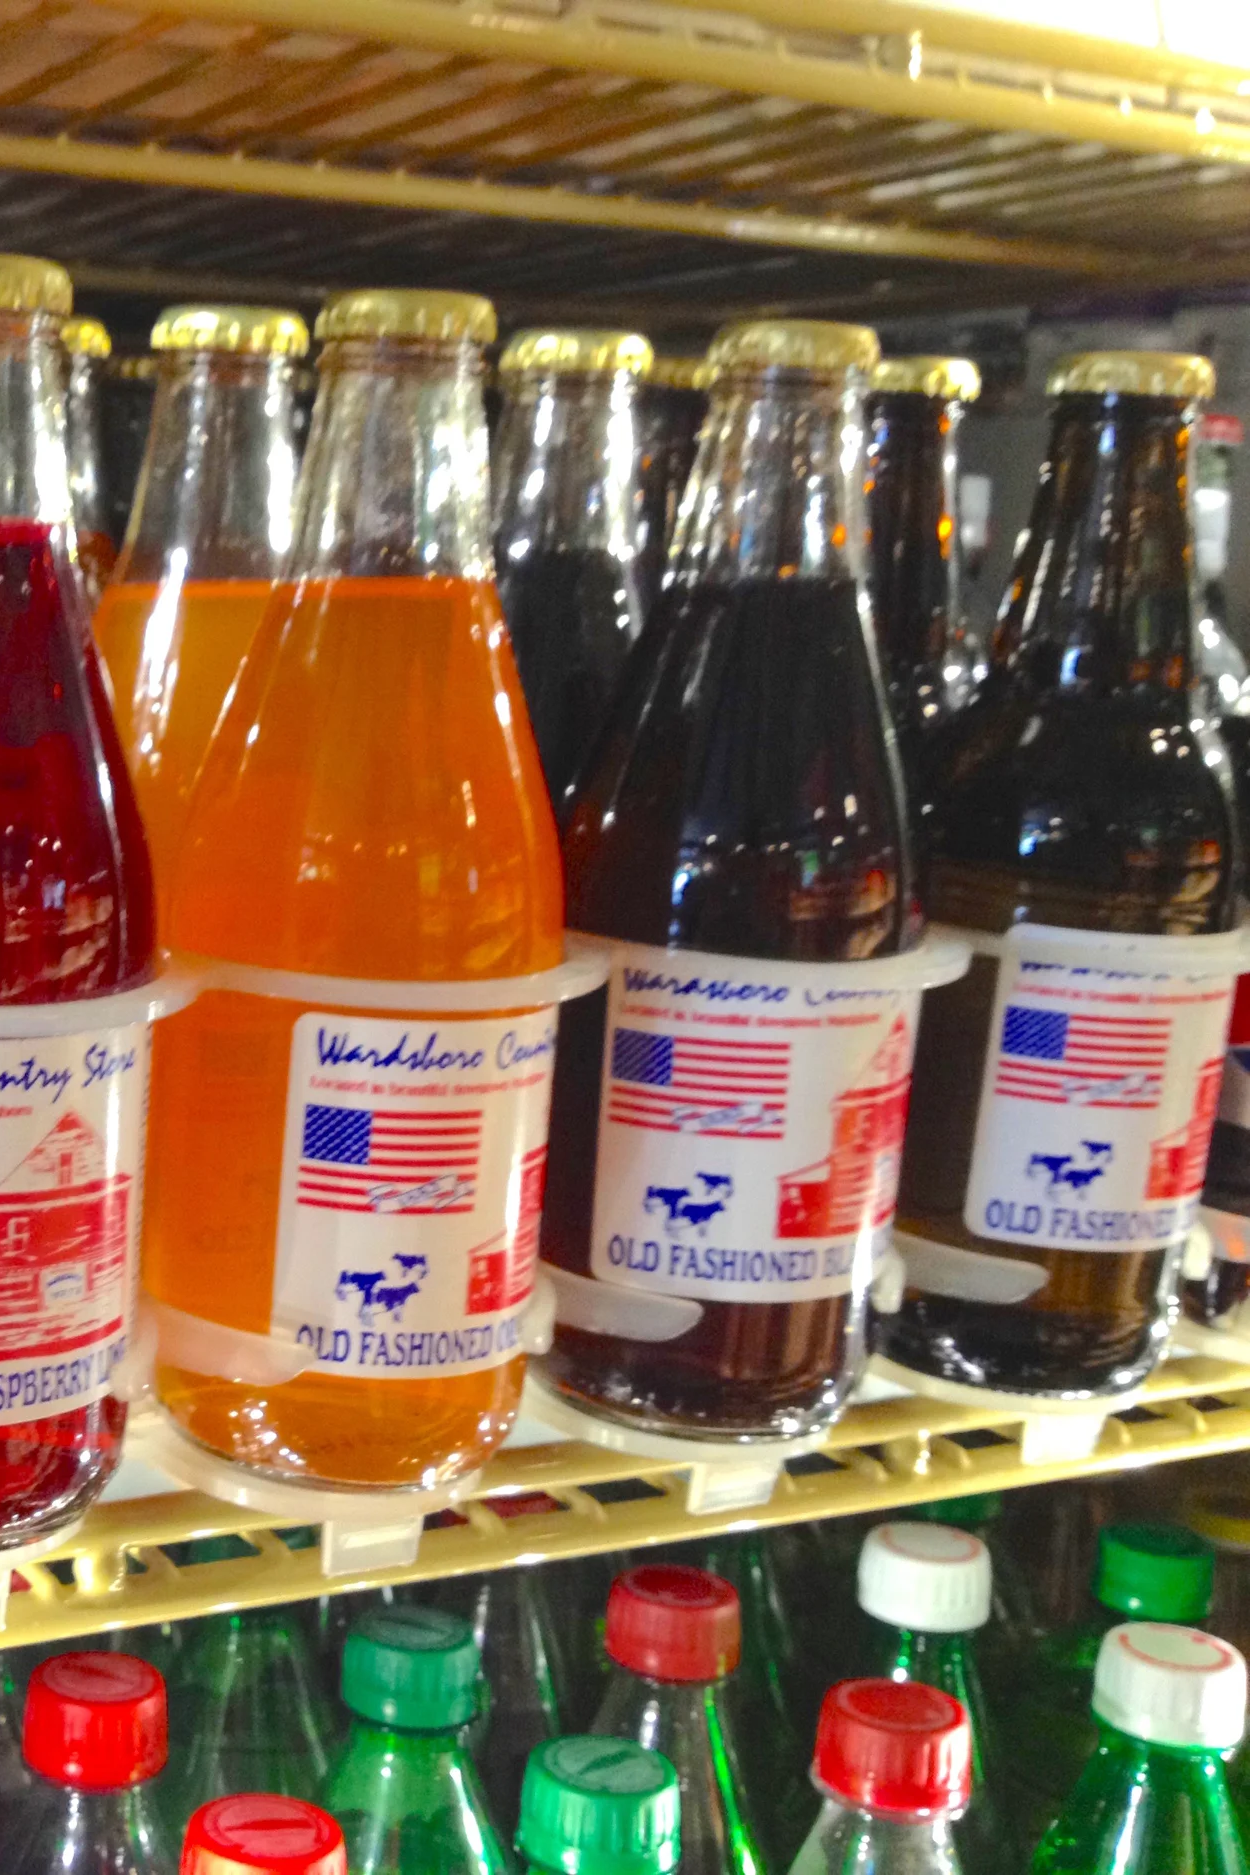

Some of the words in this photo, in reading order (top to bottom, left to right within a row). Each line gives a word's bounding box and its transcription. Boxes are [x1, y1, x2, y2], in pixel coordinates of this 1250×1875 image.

[82, 1042, 136, 1089] Store
[318, 1027, 483, 1071] Wardsboro
[986, 1199, 1042, 1235] OLD
[608, 1234, 661, 1273] OLD
[667, 1244, 817, 1283] FASHIONED
[296, 1323, 350, 1363] OLD
[357, 1325, 493, 1367] FASHIONED
